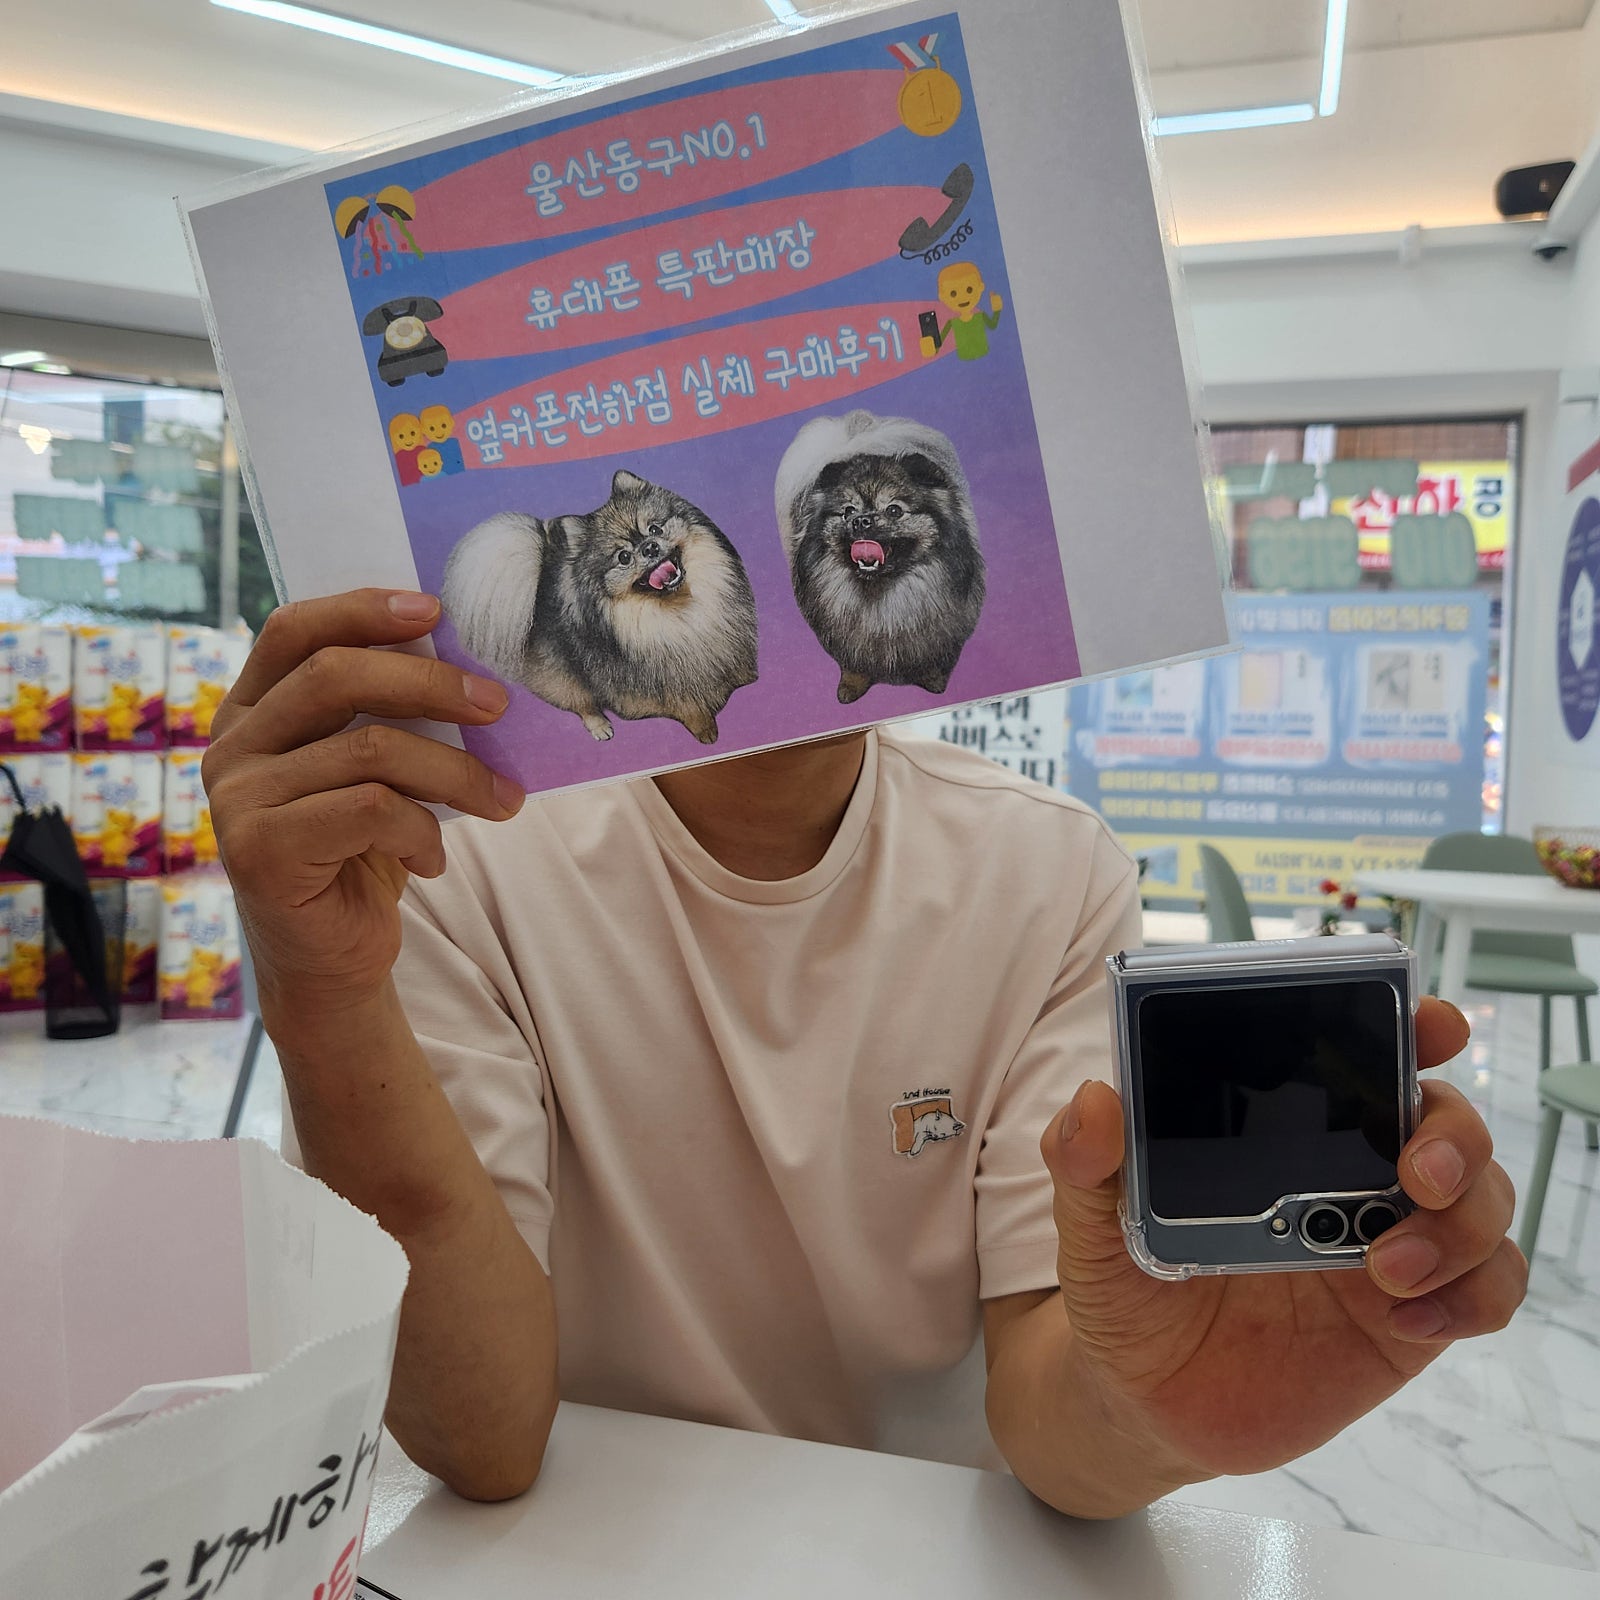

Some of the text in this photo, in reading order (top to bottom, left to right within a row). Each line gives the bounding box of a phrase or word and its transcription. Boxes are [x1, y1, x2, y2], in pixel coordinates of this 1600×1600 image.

[526, 113, 767, 217] 울산동구NO.1
[526, 220, 816, 329] 휴대폰 특판매장
[467, 318, 904, 464] 옆커폰전하점 실제 구매후기
